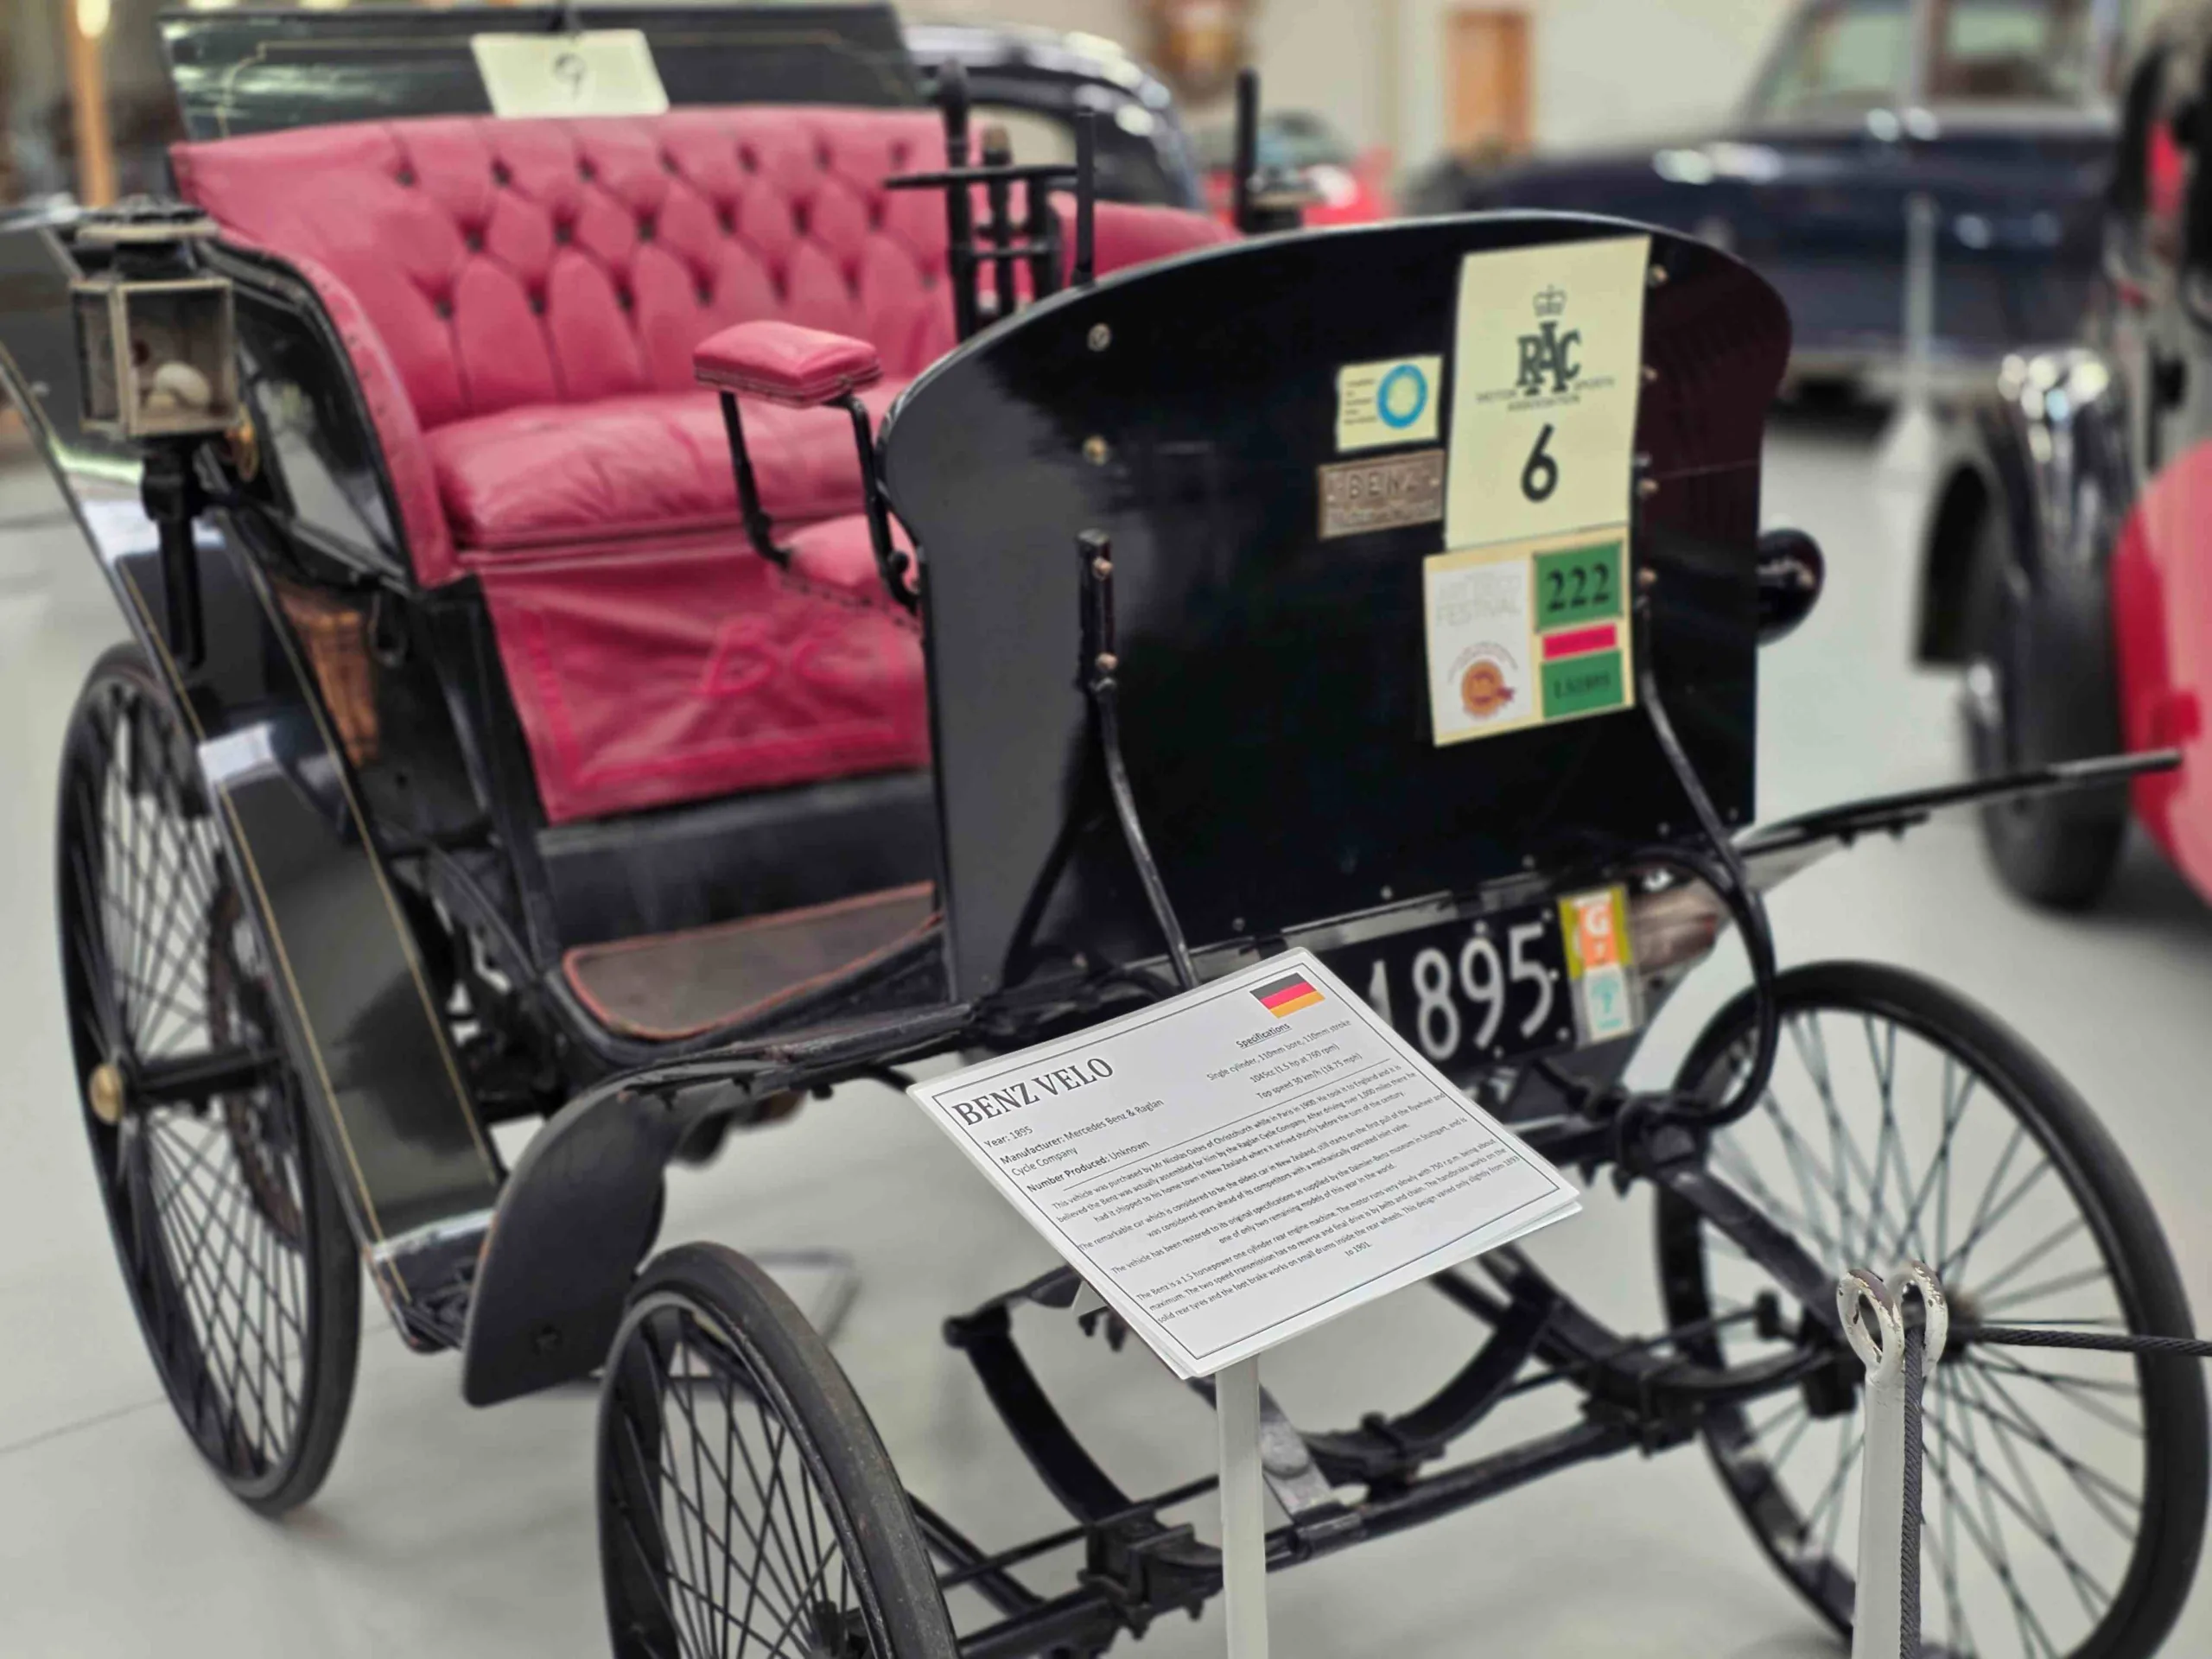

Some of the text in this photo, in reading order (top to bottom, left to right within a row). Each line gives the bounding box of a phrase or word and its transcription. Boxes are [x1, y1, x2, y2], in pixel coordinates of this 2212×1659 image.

[1516, 321, 1581, 397] RAC
[1521, 423, 1559, 502] 6
[1545, 562, 1611, 613] 222
[1206, 1020, 1351, 1081] Single cylinder, 110mm bore, 110mm stroke
[1236, 1023, 1292, 1049] Specifications
[1249, 1069, 1276, 1083] 1045cc
[1274, 1062, 1290, 1074] (1.5
[1300, 1055, 1309, 1064] at
[1306, 1049, 1322, 1060] 760
[1321, 1042, 1340, 1054] rpm)
[953, 1058, 1113, 1125] BENZ VELO
[1255, 1052, 1363, 1099] Top speed 30 km/h (18.75 mph)
[983, 1125, 1033, 1148] Year: 1895
[1000, 1099, 1165, 1165] Manufacturer: Mercedes Benz & Raglan
[1011, 1147, 1078, 1176] Cycle Company
[1052, 1199, 1070, 1210] This
[1068, 1189, 1094, 1204] vehicle
[1108, 1168, 1144, 1188] purchased
[1162, 1152, 1188, 1166] Nicolas
[1185, 1144, 1207, 1155] Oates
[1213, 1124, 1254, 1145] Christchurch
[1253, 1118, 1272, 1128] while
[1276, 1109, 1294, 1119] Paris
[1027, 1141, 1150, 1192] Number Produced: Unknown
[1056, 1205, 1089, 1223] believed
[1099, 1193, 1119, 1205] Benz
[1133, 1178, 1160, 1192] actually
[1159, 1162, 1194, 1181] assembled
[1236, 1136, 1261, 1149] Raglan
[1259, 1129, 1278, 1140] Cycle
[1306, 1109, 1324, 1121] After
[1094, 1224, 1134, 1245] remarkable
[1145, 1210, 1166, 1224] which
[1173, 1192, 1210, 1212] considered
[1225, 1180, 1239, 1190] the
[1237, 1172, 1260, 1185] oldest
[1258, 1166, 1269, 1176] car
[1274, 1158, 1292, 1168] New
[1317, 1141, 1331, 1151] still
[1329, 1135, 1348, 1146] starts
[1116, 1118, 1339, 1214] shipped home town Zealand where arrived shortly before
[1147, 1228, 1162, 1237] was
[1161, 1211, 1198, 1231] considered
[1198, 1205, 1217, 1217] years
[1216, 1194, 1238, 1209] ahead
[1253, 1173, 1293, 1192] competitors
[1291, 1166, 1307, 1176] with
[1311, 1147, 1351, 1167] mechanically
[1351, 1135, 1379, 1152] operated
[1110, 1151, 1390, 1274] The vehicle has been restored its original specifications supplied Daimler-Benz
[1136, 1291, 1153, 1301] The
[1150, 1284, 1170, 1295] Benz
[1192, 1256, 1233, 1277] horsepower
[1233, 1250, 1248, 1260] one
[1247, 1239, 1273, 1255] cylinder
[1273, 1232, 1287, 1243] rear
[1287, 1223, 1310, 1236] engine
[1309, 1211, 1339, 1227] machine.
[1336, 1205, 1351, 1214] The
[1350, 1196, 1370, 1209] motor
[1370, 1189, 1385, 1199] runs
[1397, 1174, 1419, 1187] slowly
[1218, 1234, 1233, 1244] one
[1240, 1224, 1256, 1235] only
[1254, 1218, 1270, 1228] two
[1268, 1205, 1303, 1222] remaining
[1300, 1194, 1325, 1208] models
[1331, 1185, 1345, 1195] this
[1344, 1179, 1358, 1191] year
[1149, 1293, 1186, 1311] maximum.
[1184, 1287, 1200, 1296] The
[1198, 1281, 1214, 1290] two
[1213, 1269, 1235, 1284] speed
[1233, 1253, 1276, 1275] transmission
[1273, 1248, 1288, 1257] has
[1297, 1233, 1322, 1248] reverse
[1320, 1225, 1335, 1236] and
[1332, 1219, 1350, 1230] final
[1348, 1213, 1366, 1224] drive
[1376, 1199, 1395, 1211] belts
[1158, 1311, 1176, 1324] solid
[1175, 1306, 1190, 1316] rear
[1189, 1299, 1209, 1310] tyres
[1208, 1291, 1223, 1303] and
[1220, 1287, 1234, 1296] the
[1232, 1280, 1250, 1291] foot
[1247, 1272, 1268, 1285] brake
[1268, 1262, 1289, 1275] works
[1297, 1249, 1316, 1263] small
[1315, 1242, 1337, 1255] drums
[1334, 1233, 1356, 1246] inside
[1354, 1228, 1367, 1236] the
[1365, 1221, 1380, 1231] rear
[1416, 1195, 1437, 1208] design
[1352, 1241, 1372, 1253] 1901.
